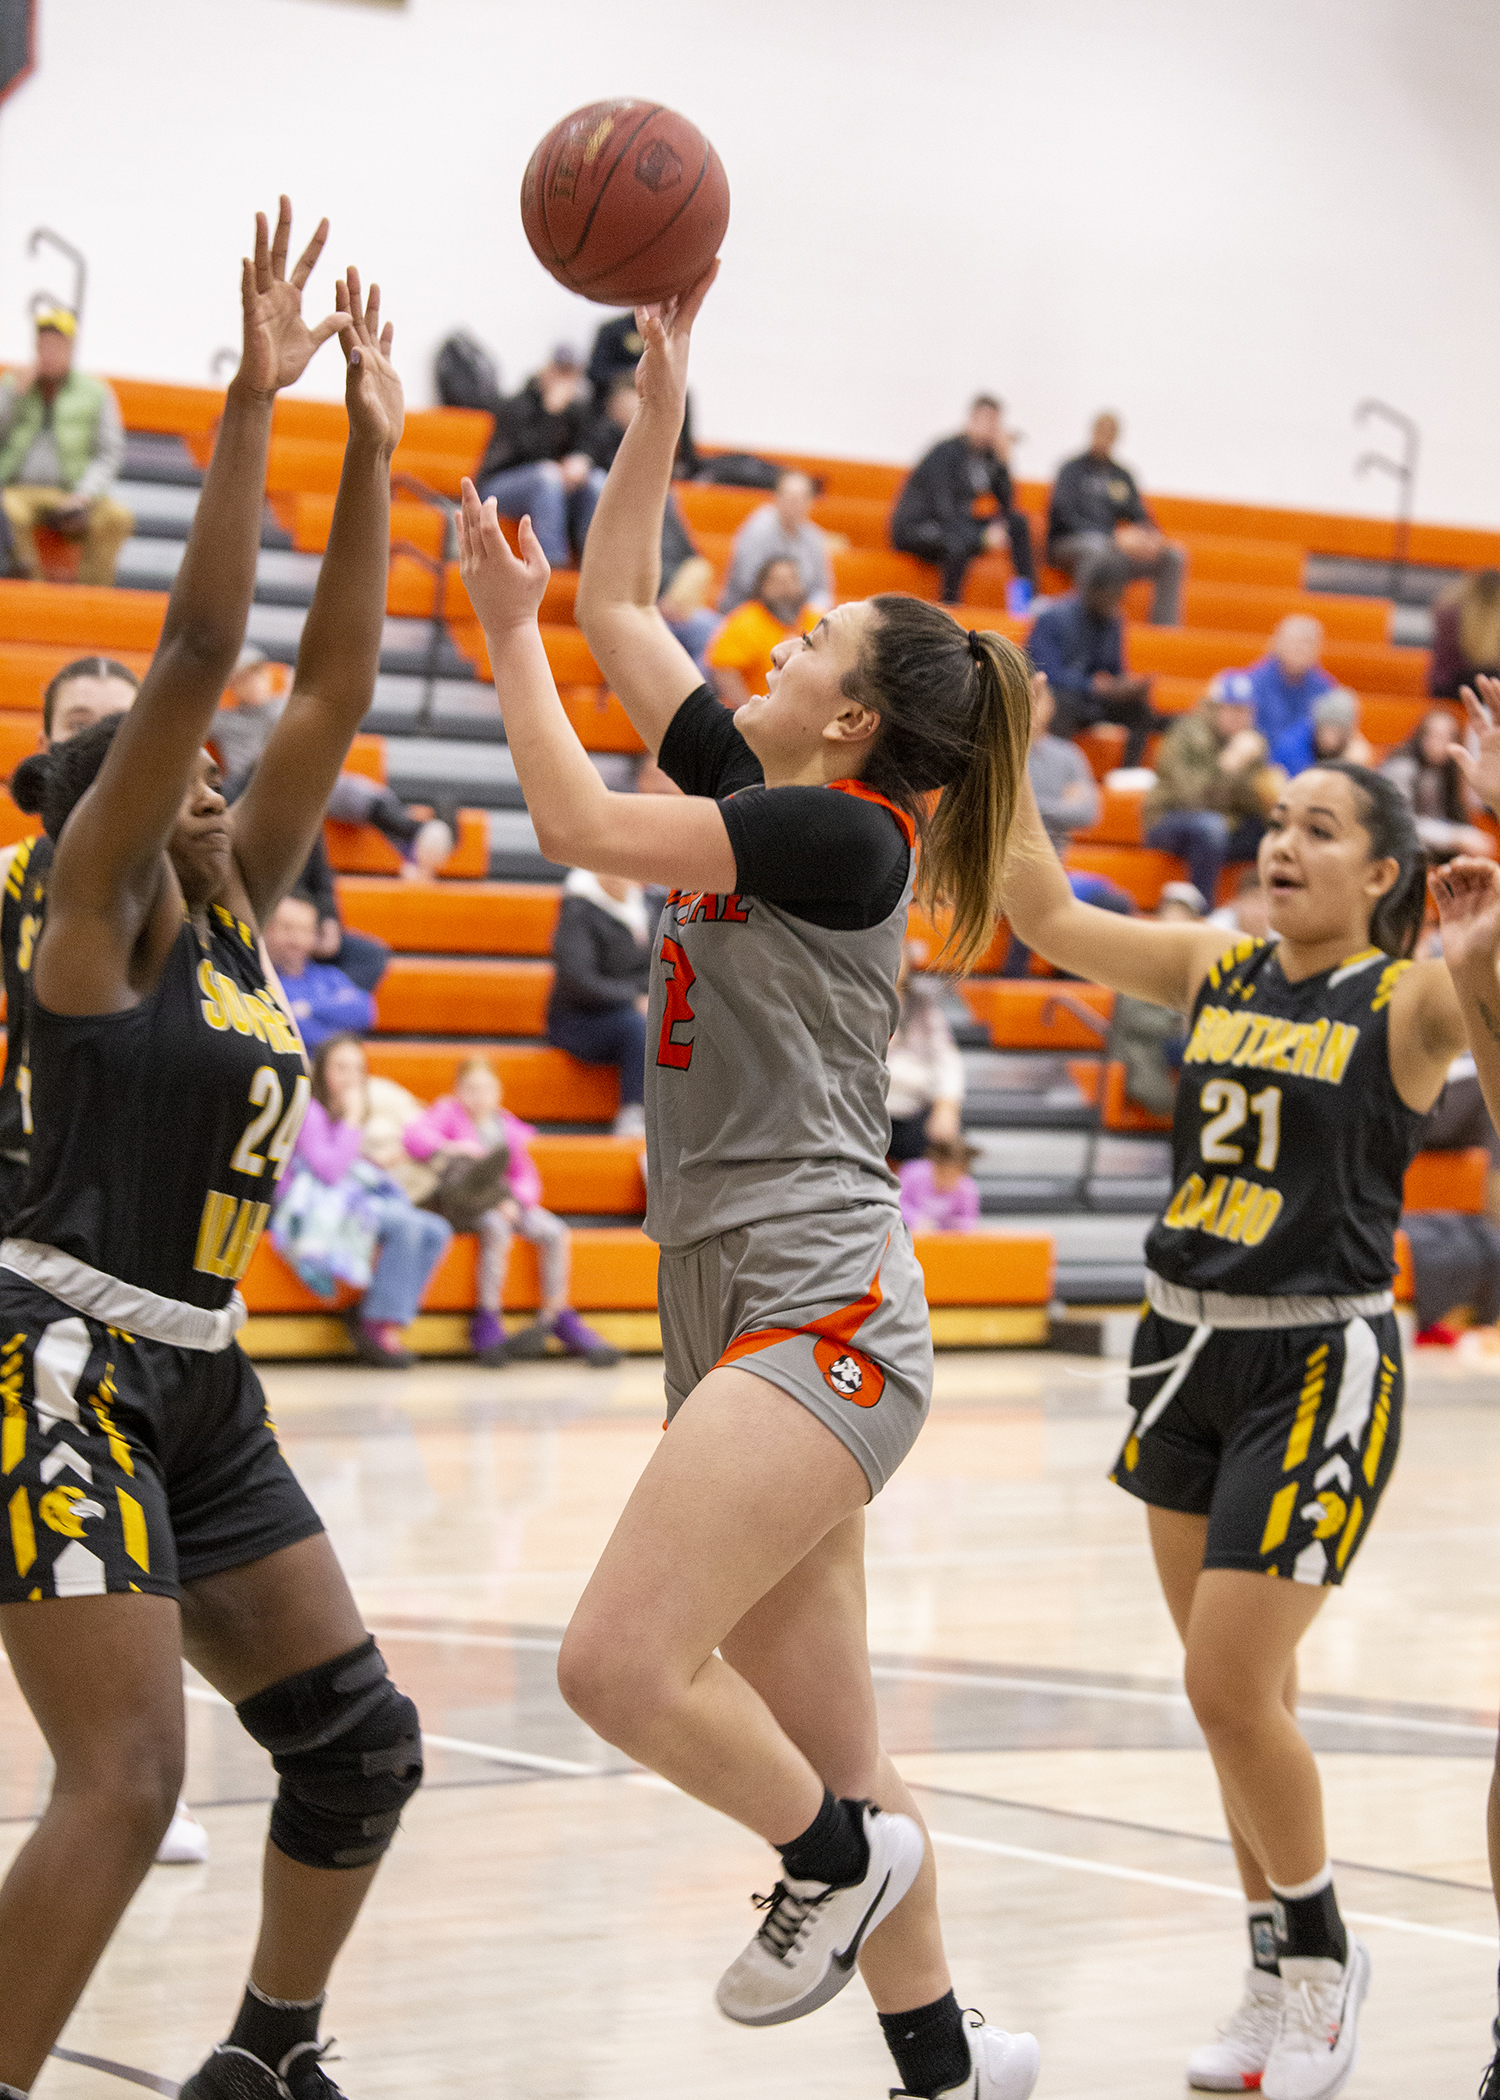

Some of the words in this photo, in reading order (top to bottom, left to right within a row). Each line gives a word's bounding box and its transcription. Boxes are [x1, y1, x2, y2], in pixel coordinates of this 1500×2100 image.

[656, 933, 697, 1071] 2
[229, 1065, 312, 1181] 24
[1201, 1077, 1282, 1173] 21
